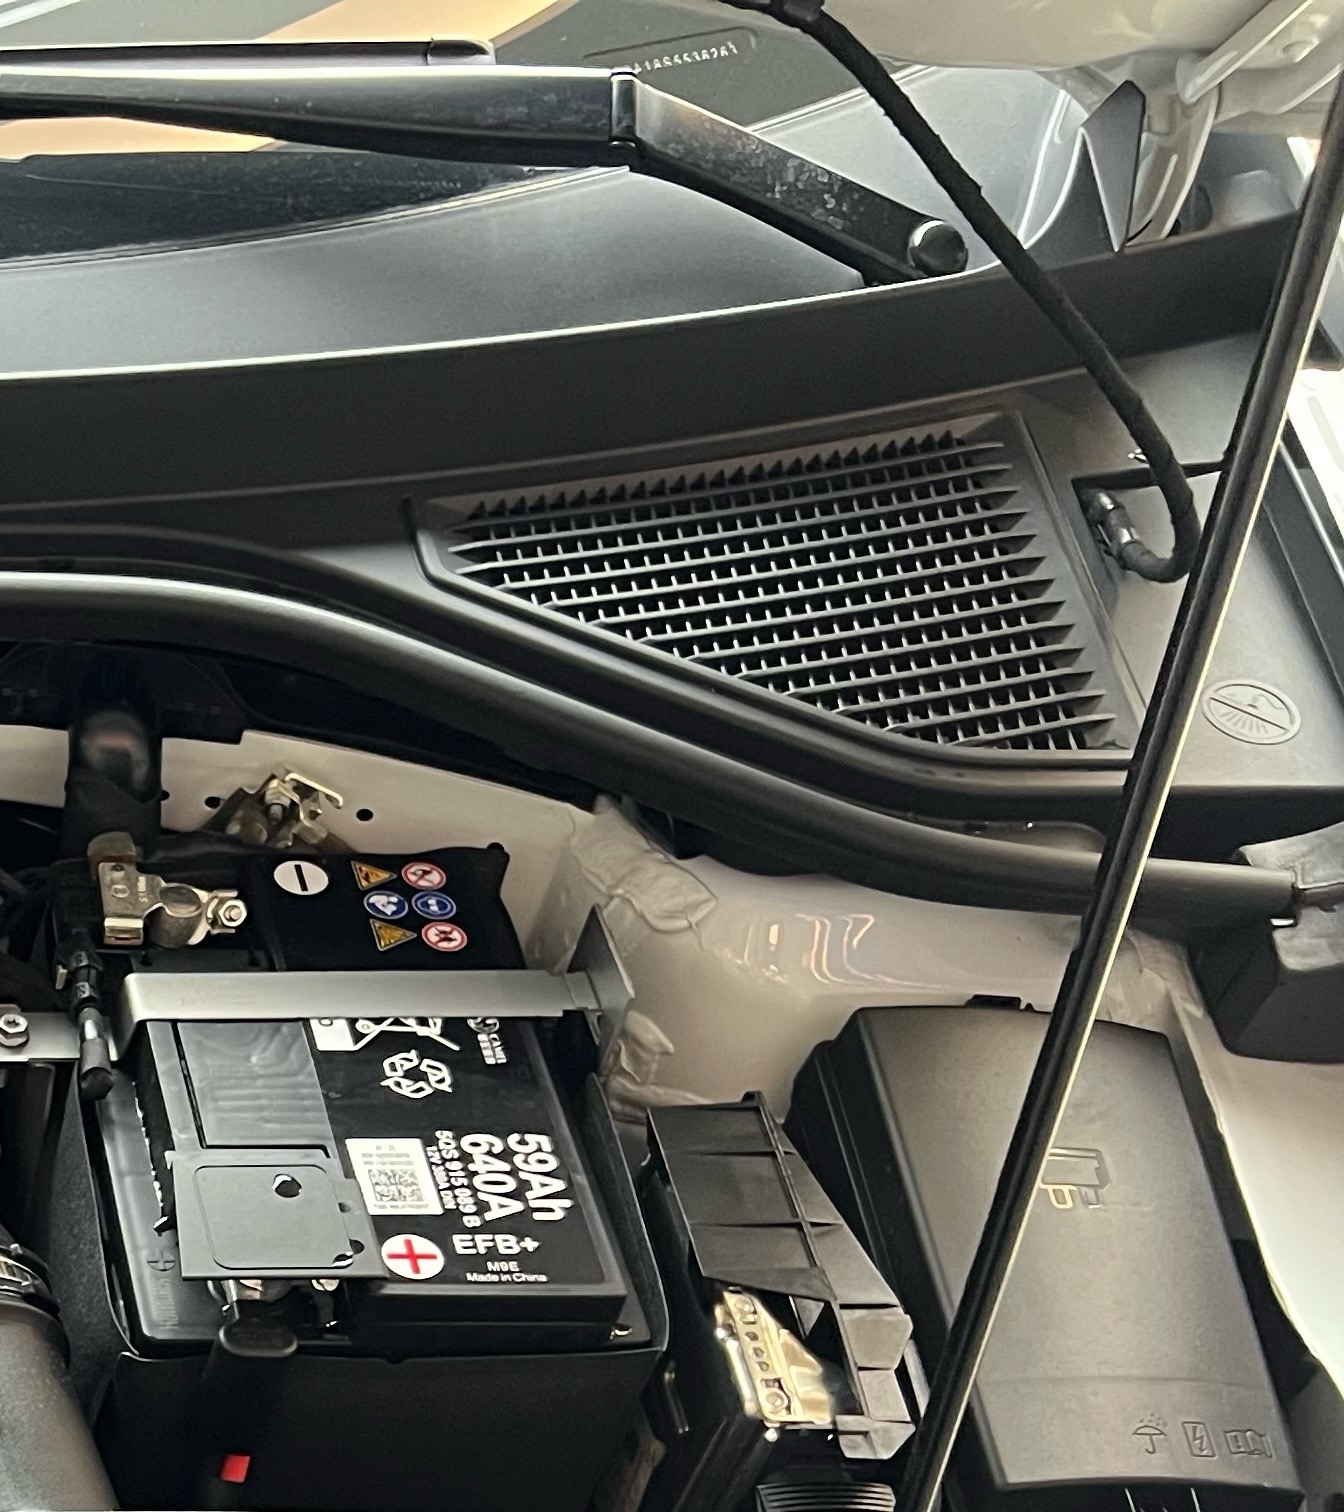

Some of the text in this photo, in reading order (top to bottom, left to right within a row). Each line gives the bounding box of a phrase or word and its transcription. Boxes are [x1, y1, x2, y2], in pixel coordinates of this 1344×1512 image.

[445, 1160, 469, 1187] 915
[462, 1214, 482, 1228] B
[460, 1133, 526, 1222] 640A
[507, 1133, 574, 1221] 59Ah
[452, 1234, 541, 1255] EFB+
[466, 1272, 500, 1282] Made
[512, 1272, 548, 1283] China
